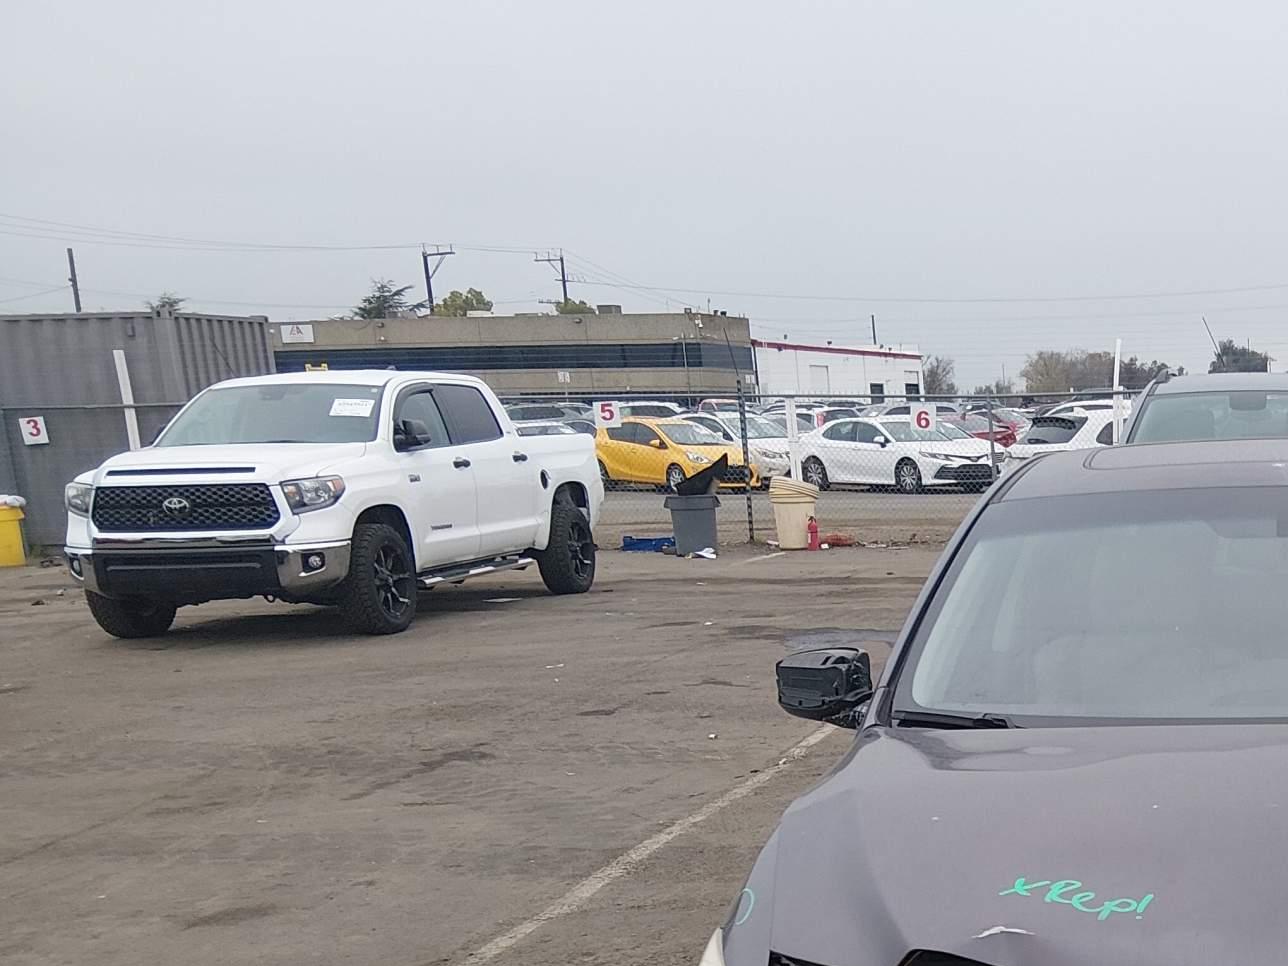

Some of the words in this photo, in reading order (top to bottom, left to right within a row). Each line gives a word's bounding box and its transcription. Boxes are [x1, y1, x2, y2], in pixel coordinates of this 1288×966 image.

[600, 403, 614, 421] 5
[916, 411, 930, 429] 6
[26, 418, 41, 437] 3
